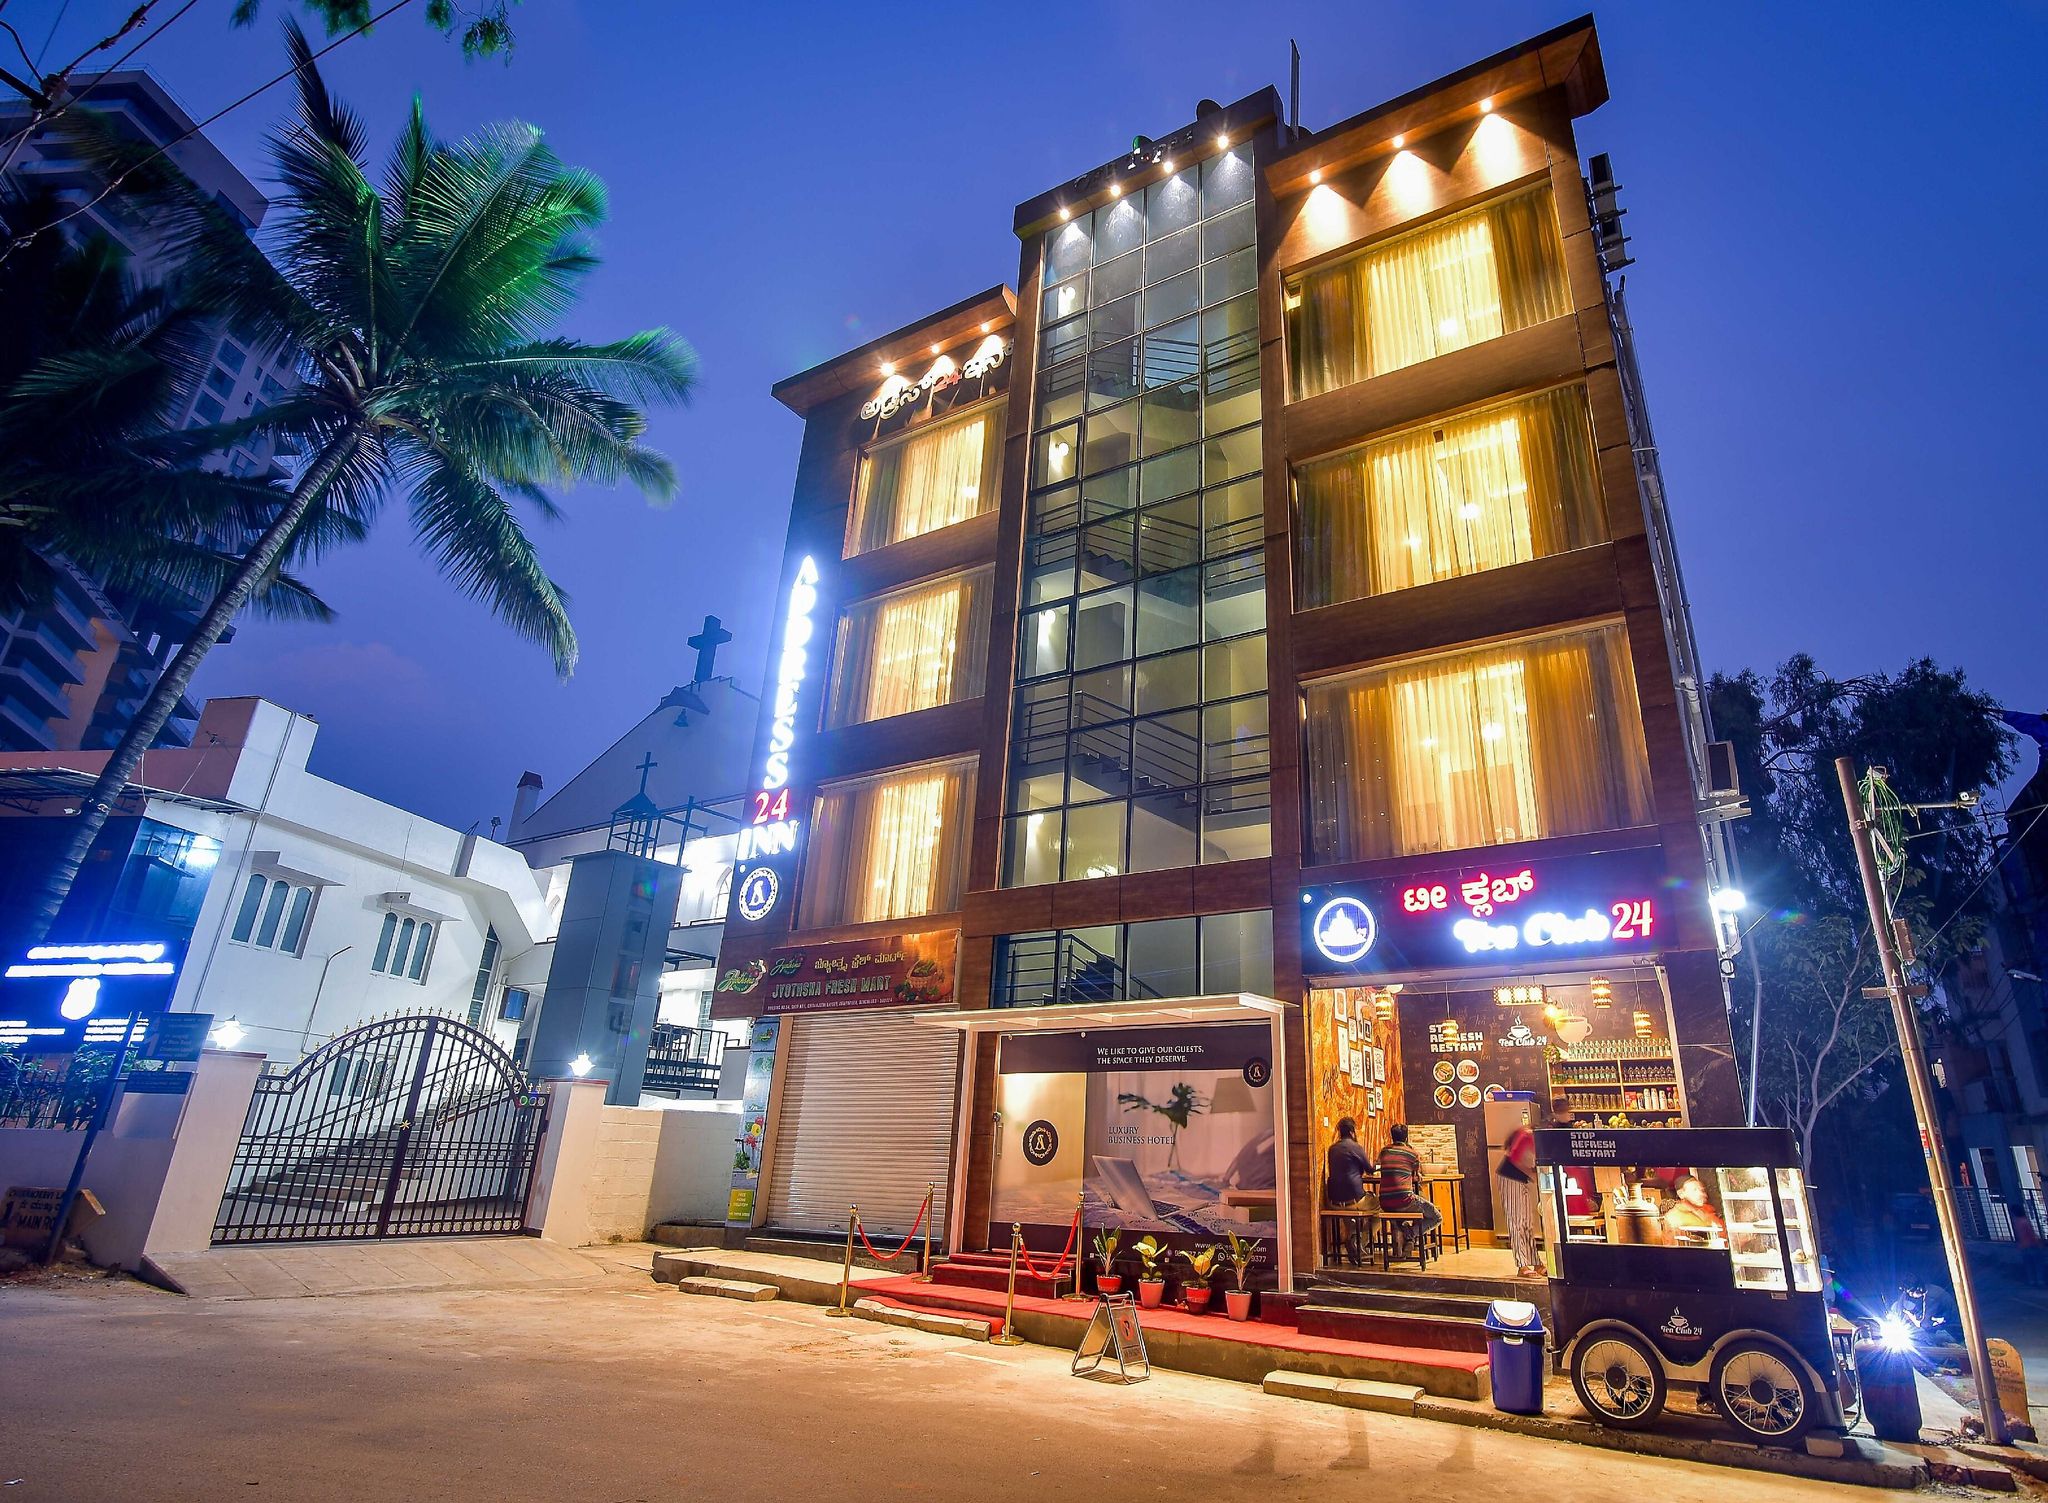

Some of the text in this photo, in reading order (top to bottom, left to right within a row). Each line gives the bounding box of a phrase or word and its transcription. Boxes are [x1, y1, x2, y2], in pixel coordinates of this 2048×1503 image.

[753, 788, 789, 825] 24
[736, 820, 800, 860] INN
[1611, 900, 1653, 939] 24
[771, 975, 892, 999] JYOTHSNA FRESH MART
[1429, 1032, 1483, 1043] REESH
[1498, 1035, 1547, 1047] Tea Club 24
[1110, 1047, 1126, 1055] LIKE
[1127, 1046, 1137, 1055] TO
[1138, 1046, 1156, 1054] GIVE
[1157, 1046, 1174, 1054] OUR
[1174, 1045, 1204, 1054] GUESTS,
[1430, 1041, 1483, 1053] RESTART
[1096, 1054, 1188, 1065] THE SPACE THEY DESERVE.
[1108, 1126, 1140, 1135] LUXURY
[1570, 1131, 1596, 1140] STOP
[1108, 1135, 1175, 1145] BUSINESS HOTEL
[1571, 1140, 1616, 1149] REFRESH
[1572, 1149, 1617, 1158] RESTART
[1660, 1325, 1703, 1336] Tea Club 24
